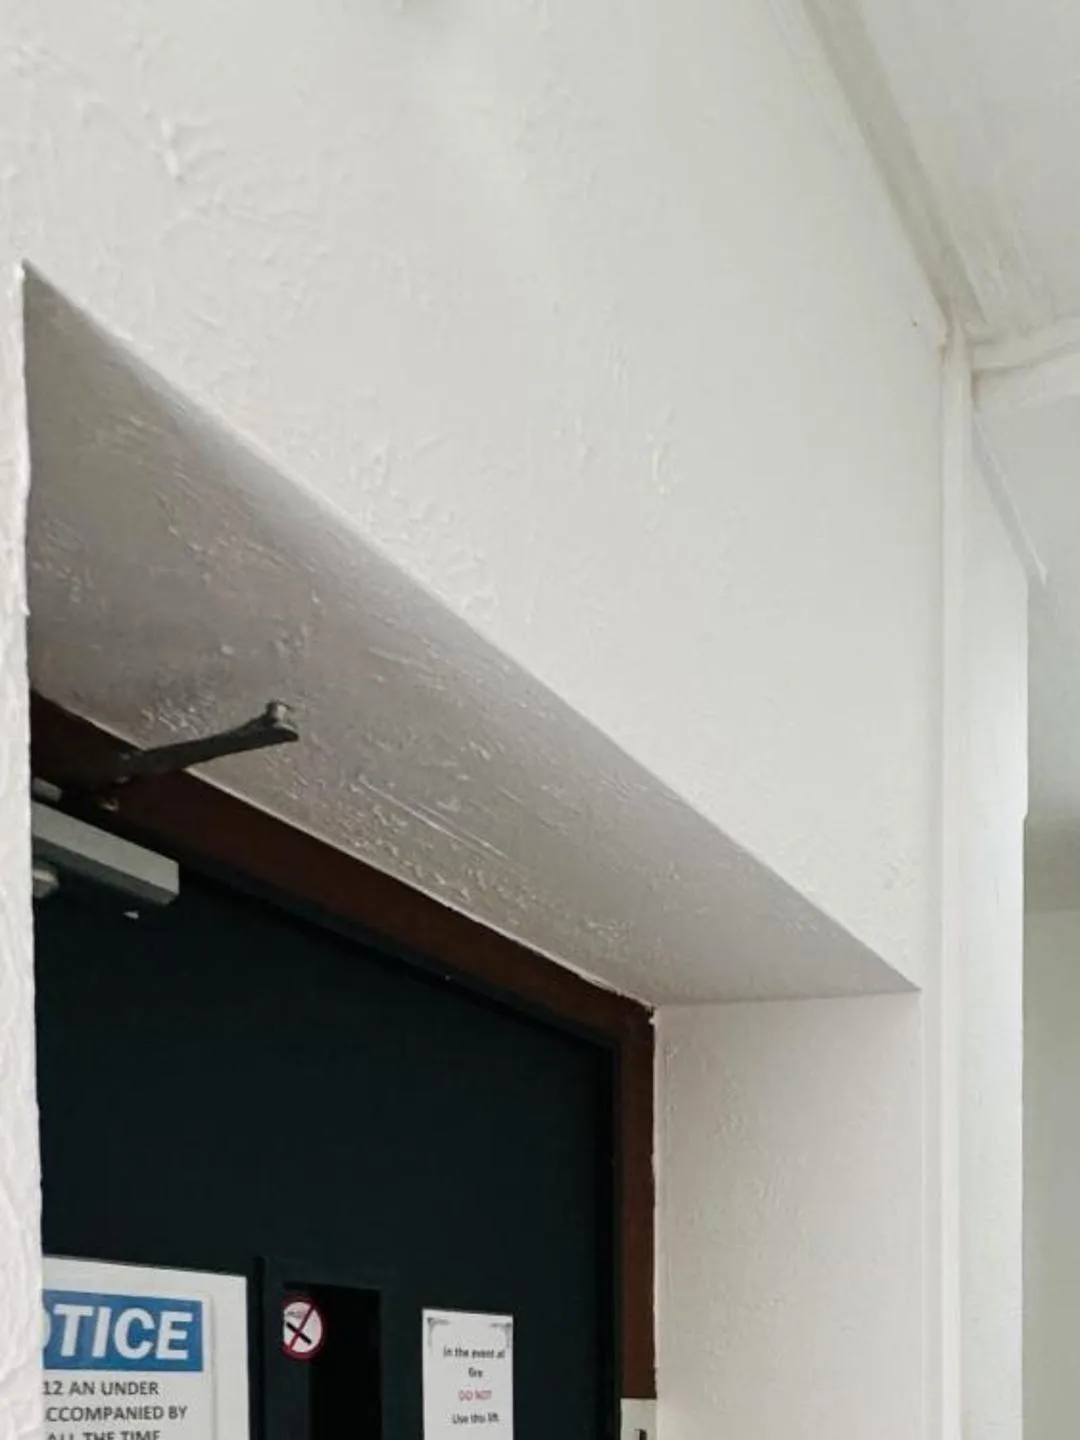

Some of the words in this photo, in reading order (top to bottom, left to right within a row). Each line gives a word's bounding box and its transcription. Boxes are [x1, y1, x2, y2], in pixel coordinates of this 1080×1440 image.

[41, 1303, 194, 1361] TICE
[44, 1381, 63, 1396] 12
[69, 1381, 95, 1396] AN
[101, 1381, 160, 1396] UNDER
[168, 1404, 189, 1421] BY
